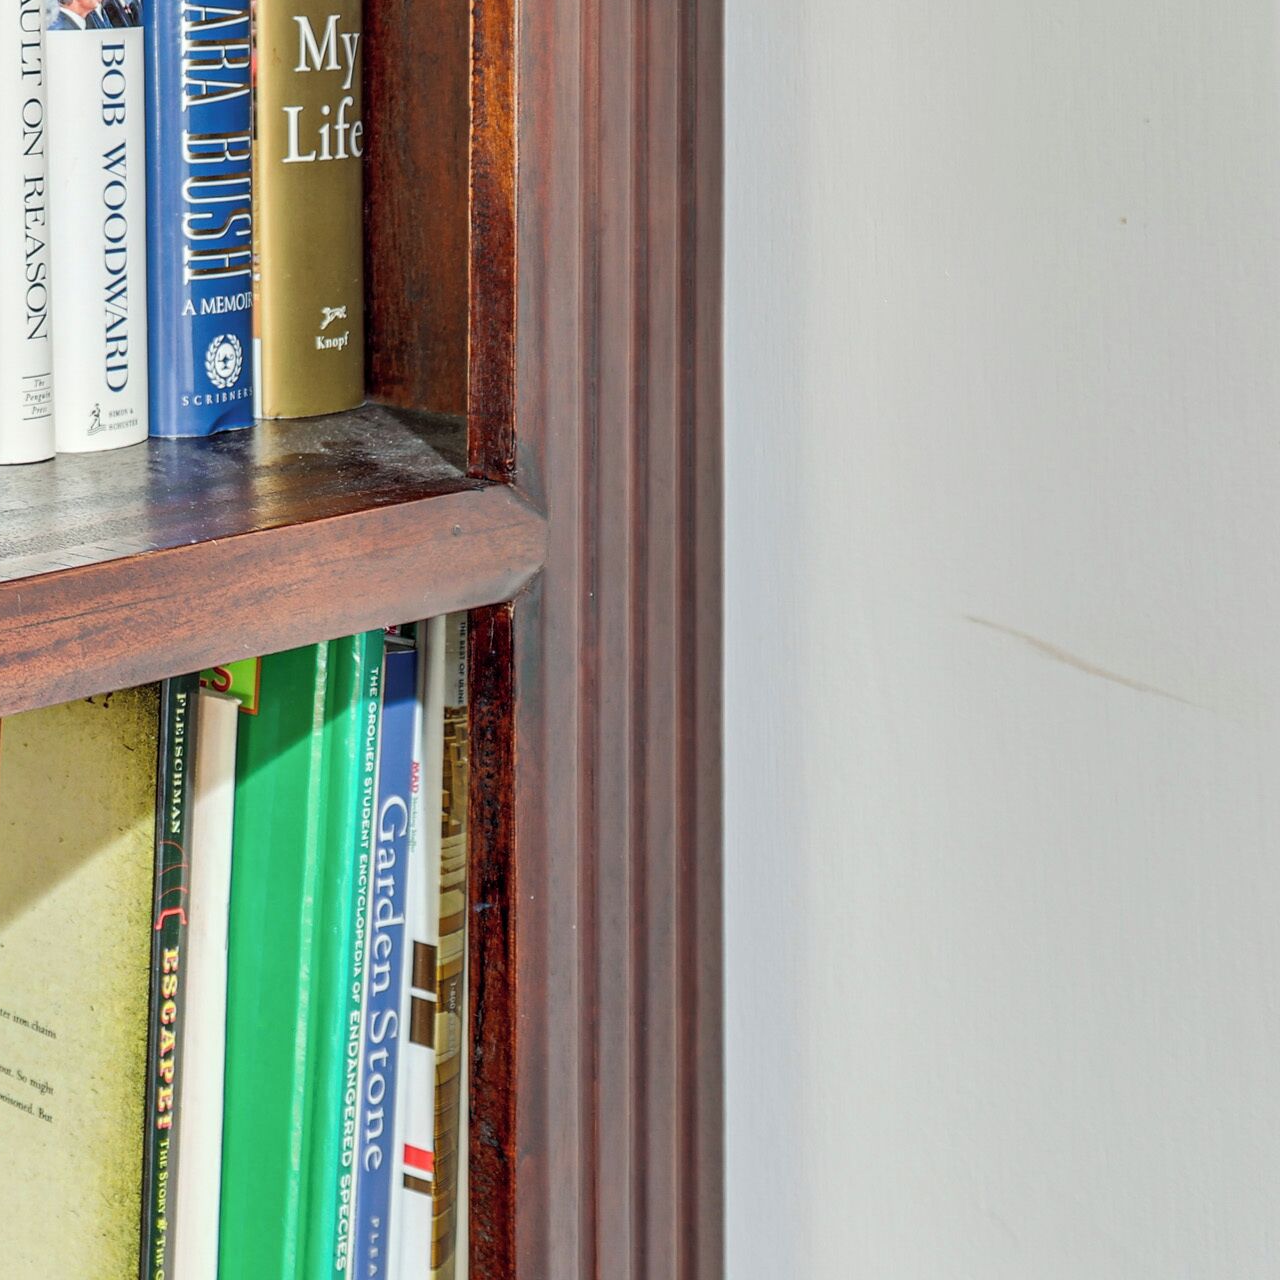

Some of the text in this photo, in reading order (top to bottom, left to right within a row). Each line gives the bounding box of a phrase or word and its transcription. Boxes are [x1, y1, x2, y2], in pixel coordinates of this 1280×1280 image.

[101, 40, 126, 126] BOB
[292, 14, 360, 90] My
[22, 100, 44, 158] ON
[281, 97, 364, 164] Life
[181, 129, 252, 286] BUSH
[23, 176, 49, 342] REASON
[102, 139, 129, 394] WOODWARD
[182, 291, 254, 316] A MEMOIR
[315, 331, 350, 350] Knopf
[182, 387, 253, 407] SCRIBNERS
[170, 693, 187, 835] FLEISCHMAN
[336, 666, 380, 1272] THE GROLIER STUDENT ENCYCLOPEDIA ENDANGERED SPECIES
[364, 795, 408, 1172] Garden Stone
[157, 948, 179, 1130] ESCAPE!
[157, 1171, 169, 1213] STORY
